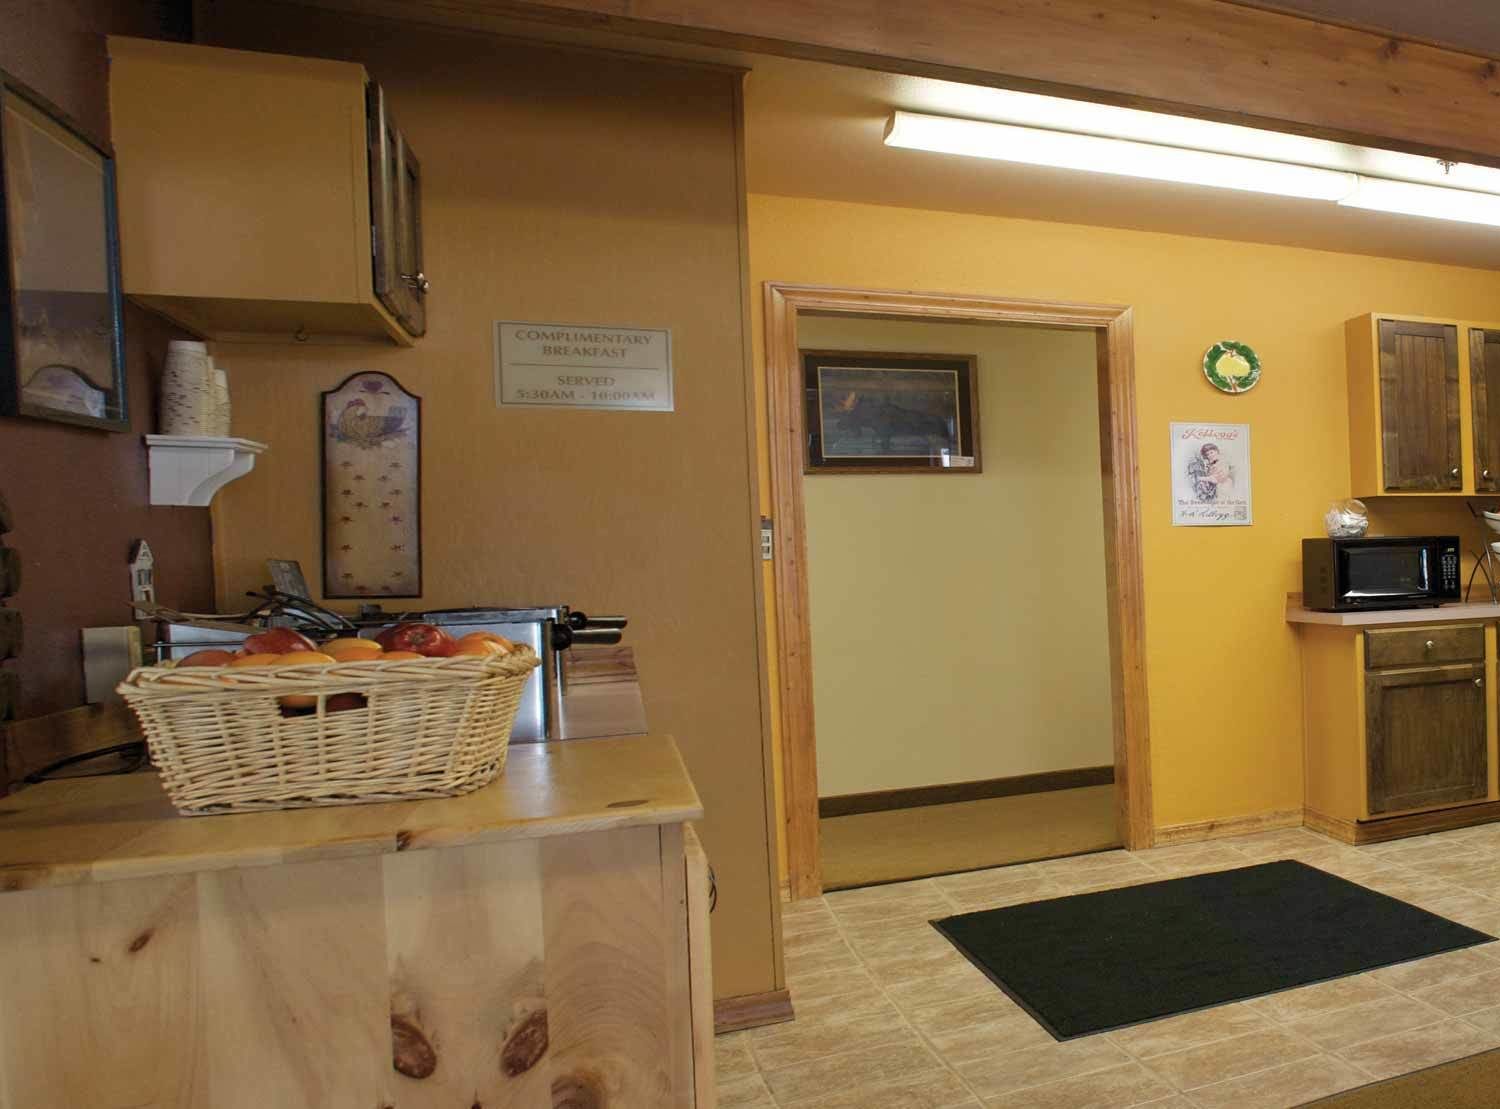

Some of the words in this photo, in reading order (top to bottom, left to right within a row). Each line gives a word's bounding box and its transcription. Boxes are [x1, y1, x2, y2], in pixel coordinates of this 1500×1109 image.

[514, 329, 653, 345] COMPLIMENTARY
[543, 345, 628, 359] BREAKFAST
[557, 375, 616, 387] SERVED
[516, 388, 576, 400] 5:30AM
